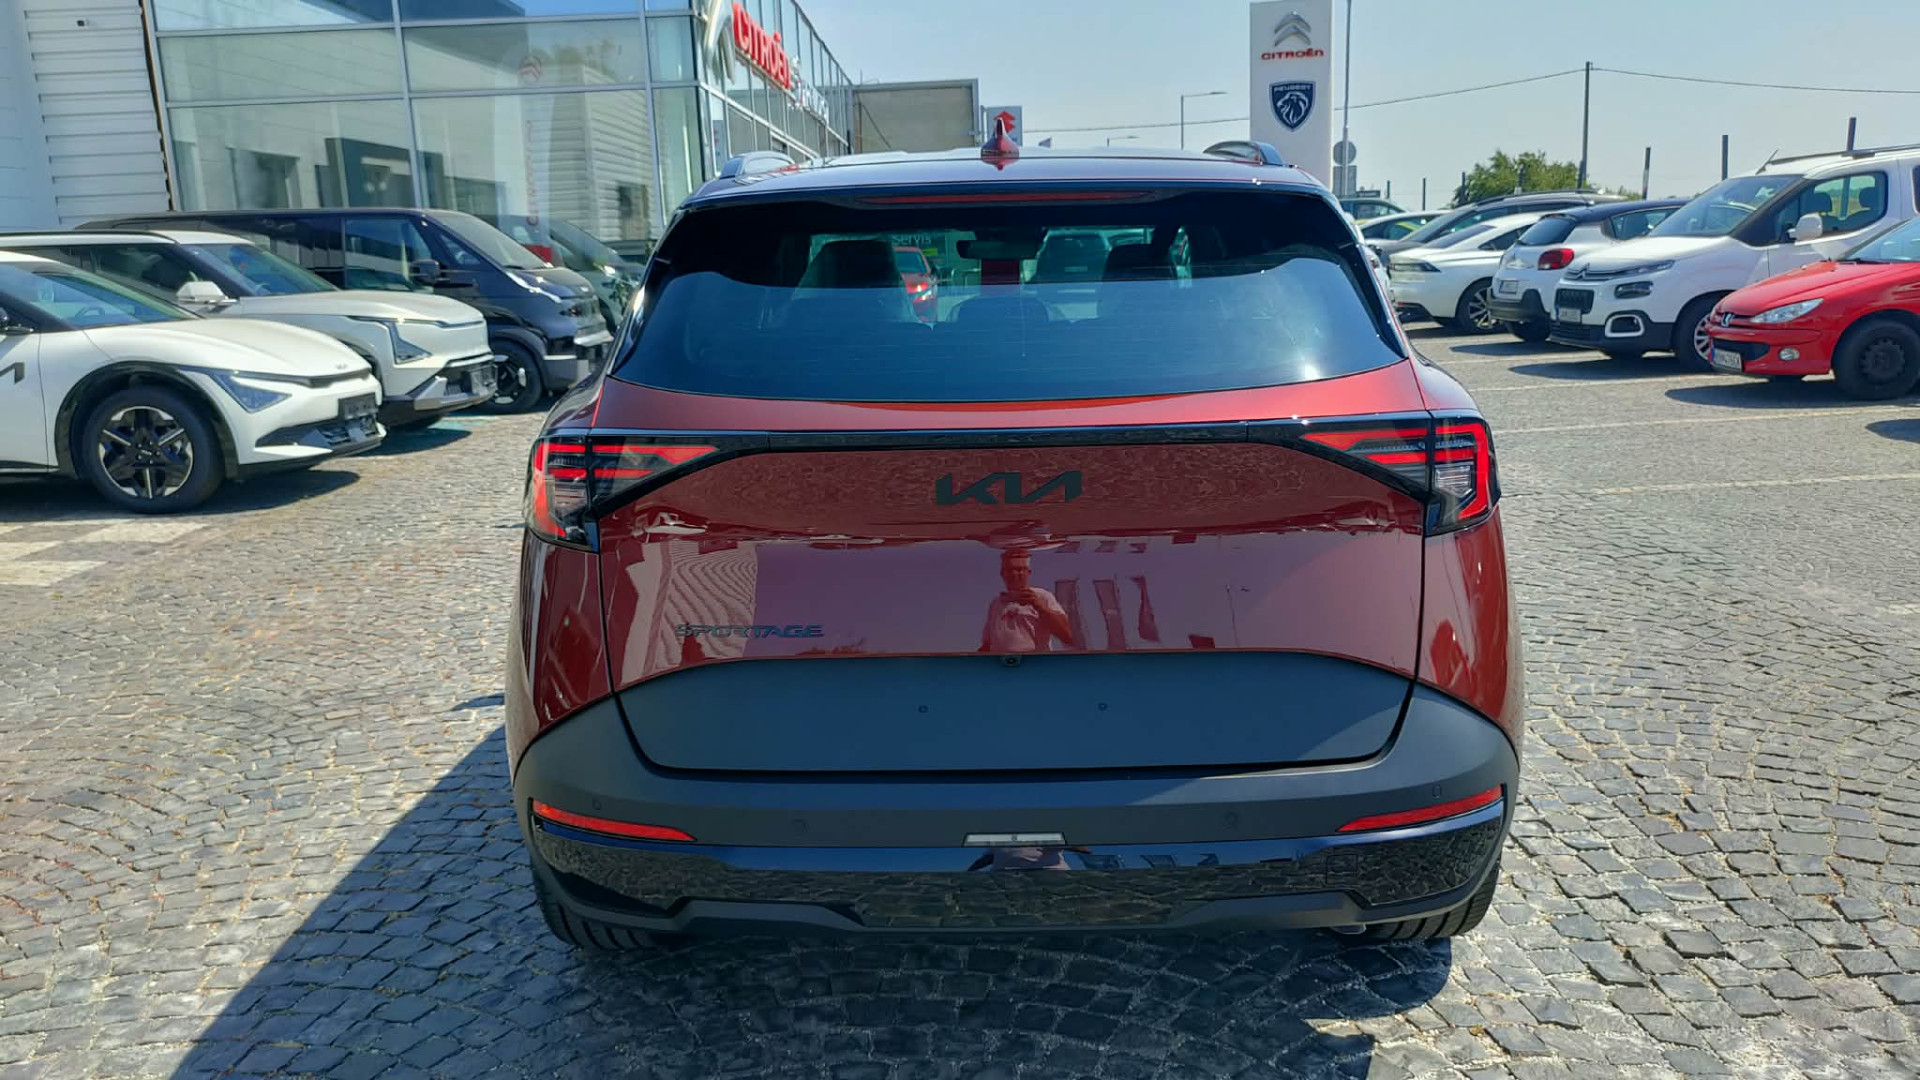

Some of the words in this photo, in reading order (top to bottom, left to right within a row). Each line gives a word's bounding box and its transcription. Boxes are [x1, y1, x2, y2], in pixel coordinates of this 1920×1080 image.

[1261, 48, 1324, 60] CITROËN
[935, 470, 1083, 505] KIA
[675, 624, 825, 639] SPORTAGE
